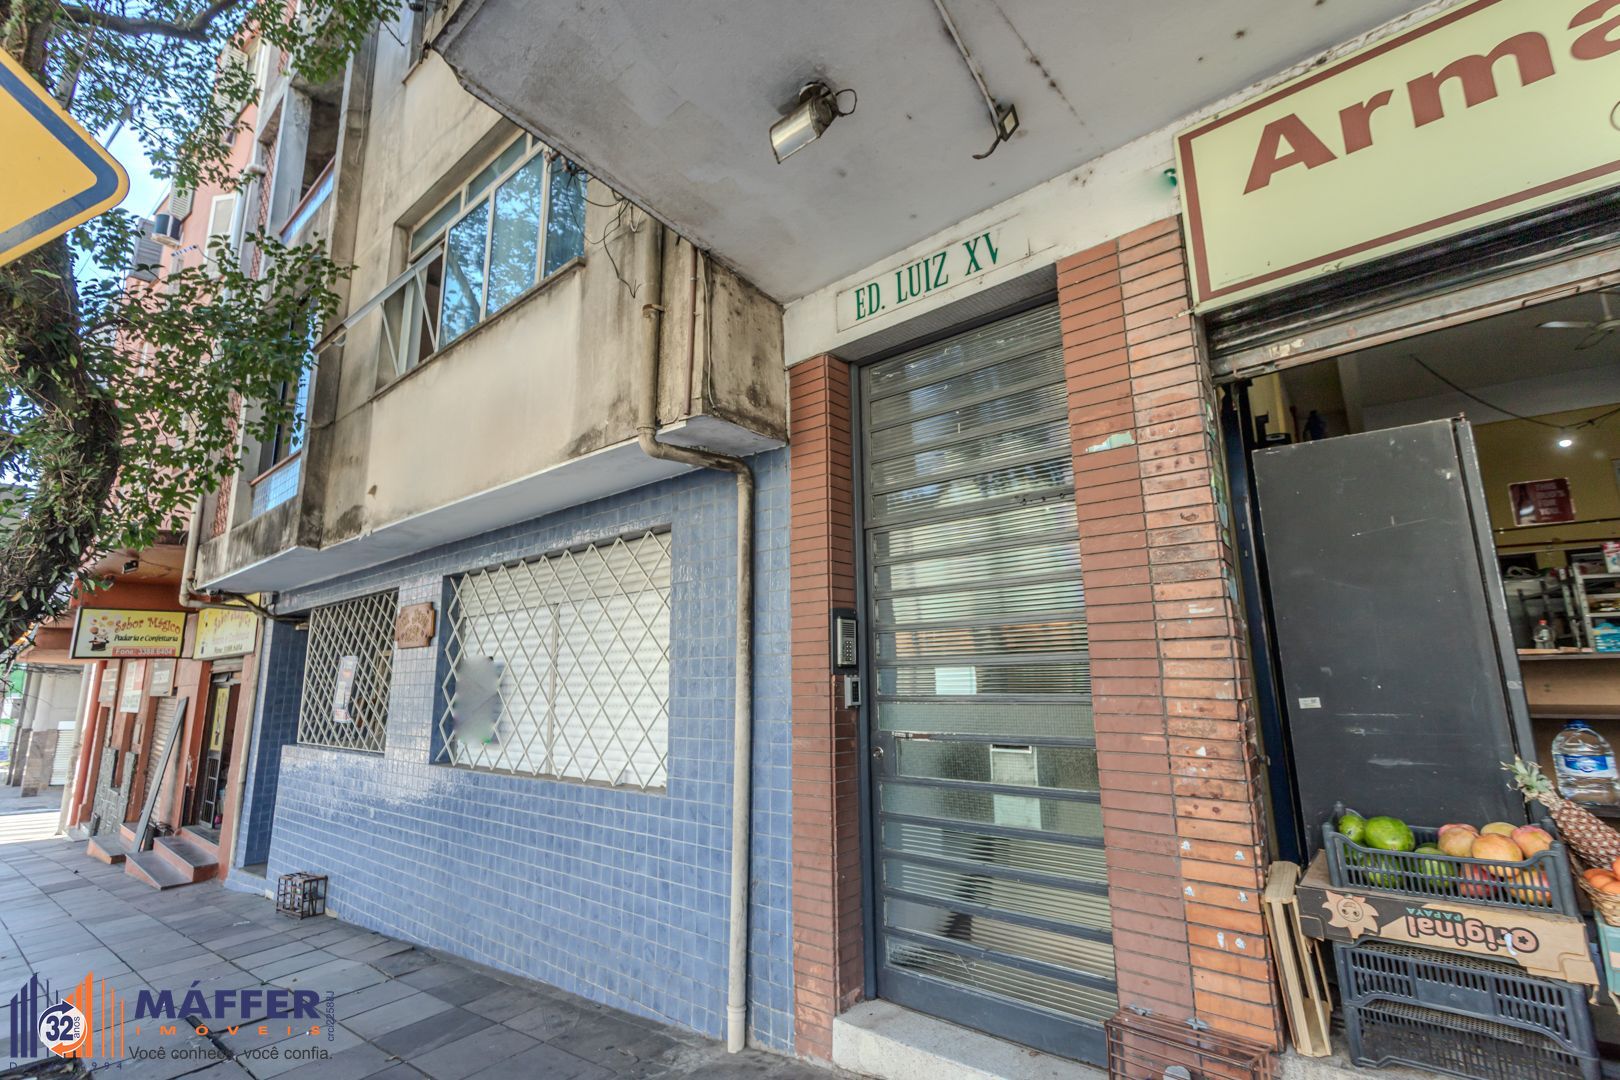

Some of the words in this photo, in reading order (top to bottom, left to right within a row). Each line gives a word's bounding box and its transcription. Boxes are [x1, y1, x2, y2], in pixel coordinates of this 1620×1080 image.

[854, 282, 885, 321] ED.
[895, 251, 949, 304] LUIZ
[962, 231, 1000, 277] XV
[114, 616, 144, 633] Sabor
[147, 616, 181, 635] Mágico
[114, 634, 139, 642] Padaria
[144, 634, 178, 642] Confeitaria
[1406, 907, 1463, 922] PAPAYA
[1406, 915, 1540, 954] Original
